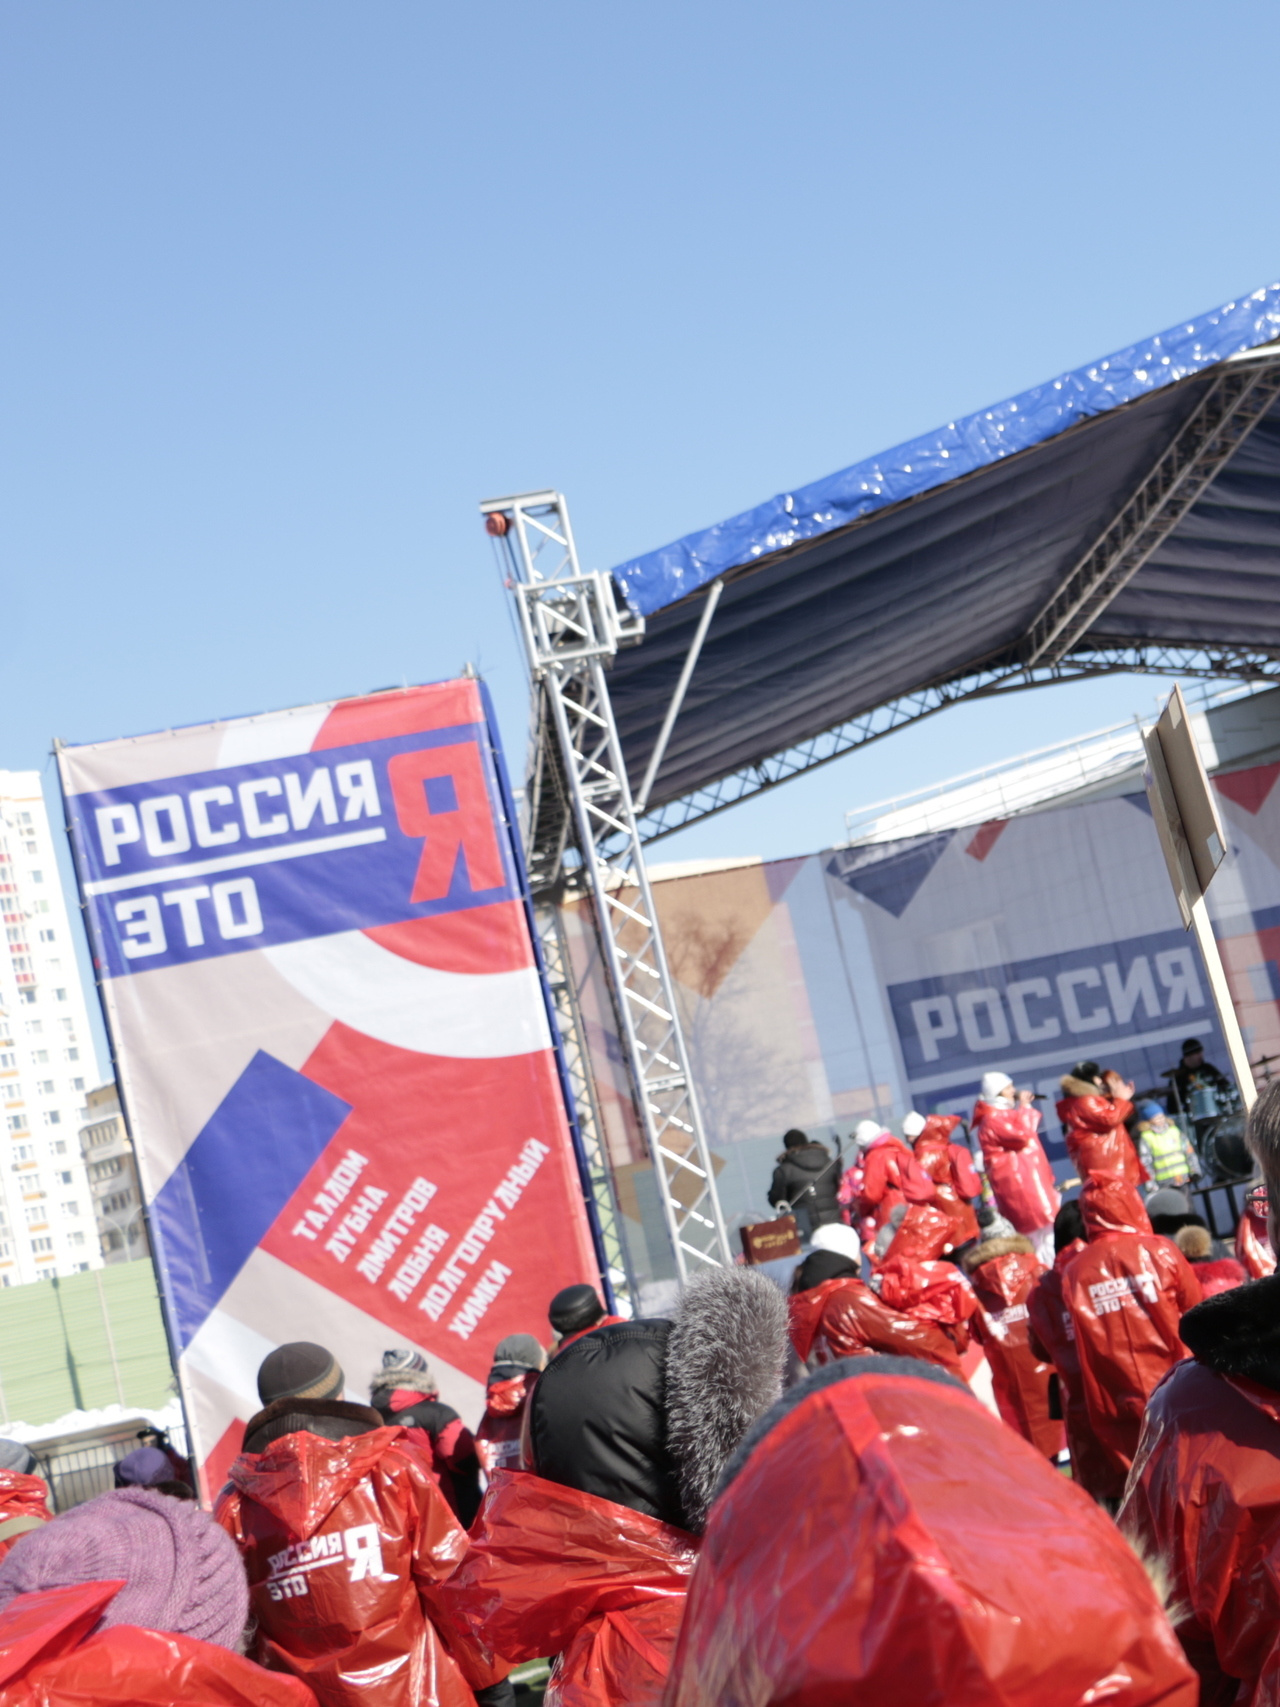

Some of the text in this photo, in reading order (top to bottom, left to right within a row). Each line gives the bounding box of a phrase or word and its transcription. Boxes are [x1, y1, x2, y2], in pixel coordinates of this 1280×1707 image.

[94, 759, 382, 866] РОССИЯ
[387, 740, 506, 904] Я
[115, 877, 264, 959] ЭТО
[910, 946, 1206, 1062] РОССИЯ
[292, 1148, 369, 1241] ТАЛДОМ
[324, 1184, 389, 1264] ДУБНА
[356, 1176, 438, 1285] ДМИТРОВ
[418, 1137, 551, 1322] ДОЛГОПРУДНЫЙ
[387, 1223, 450, 1303] ЛОБНЯ
[448, 1259, 513, 1341] ХИМКИ
[266, 1574, 309, 1601] ЭТО
[344, 1523, 384, 1583] Я
